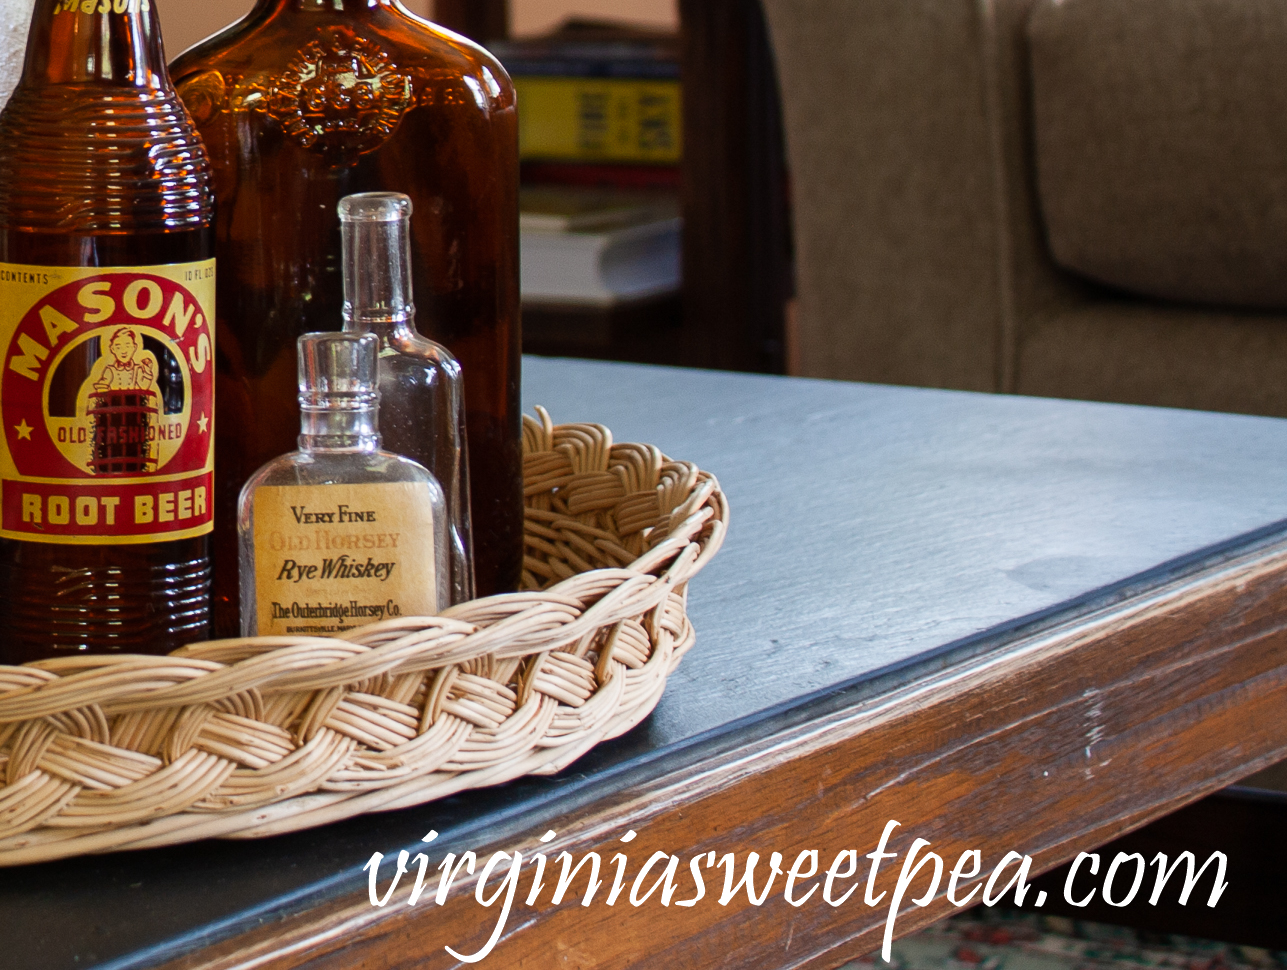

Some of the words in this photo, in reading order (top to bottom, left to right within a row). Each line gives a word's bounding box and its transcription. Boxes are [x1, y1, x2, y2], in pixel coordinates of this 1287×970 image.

[0, 269, 49, 285] CONTENTS
[185, 271, 192, 281] 10
[9, 279, 211, 381] MASON'S
[57, 425, 87, 444] OLD
[96, 422, 182, 444] FASHIONED
[22, 493, 120, 526] ROOT
[134, 486, 207, 524] BEER
[314, 529, 401, 551] HORSEY
[276, 559, 318, 583] Rye
[320, 554, 396, 582] Whiskey
[271, 601, 291, 619] The
[349, 600, 385, 620] Horsey
[386, 599, 402, 616] Co.
